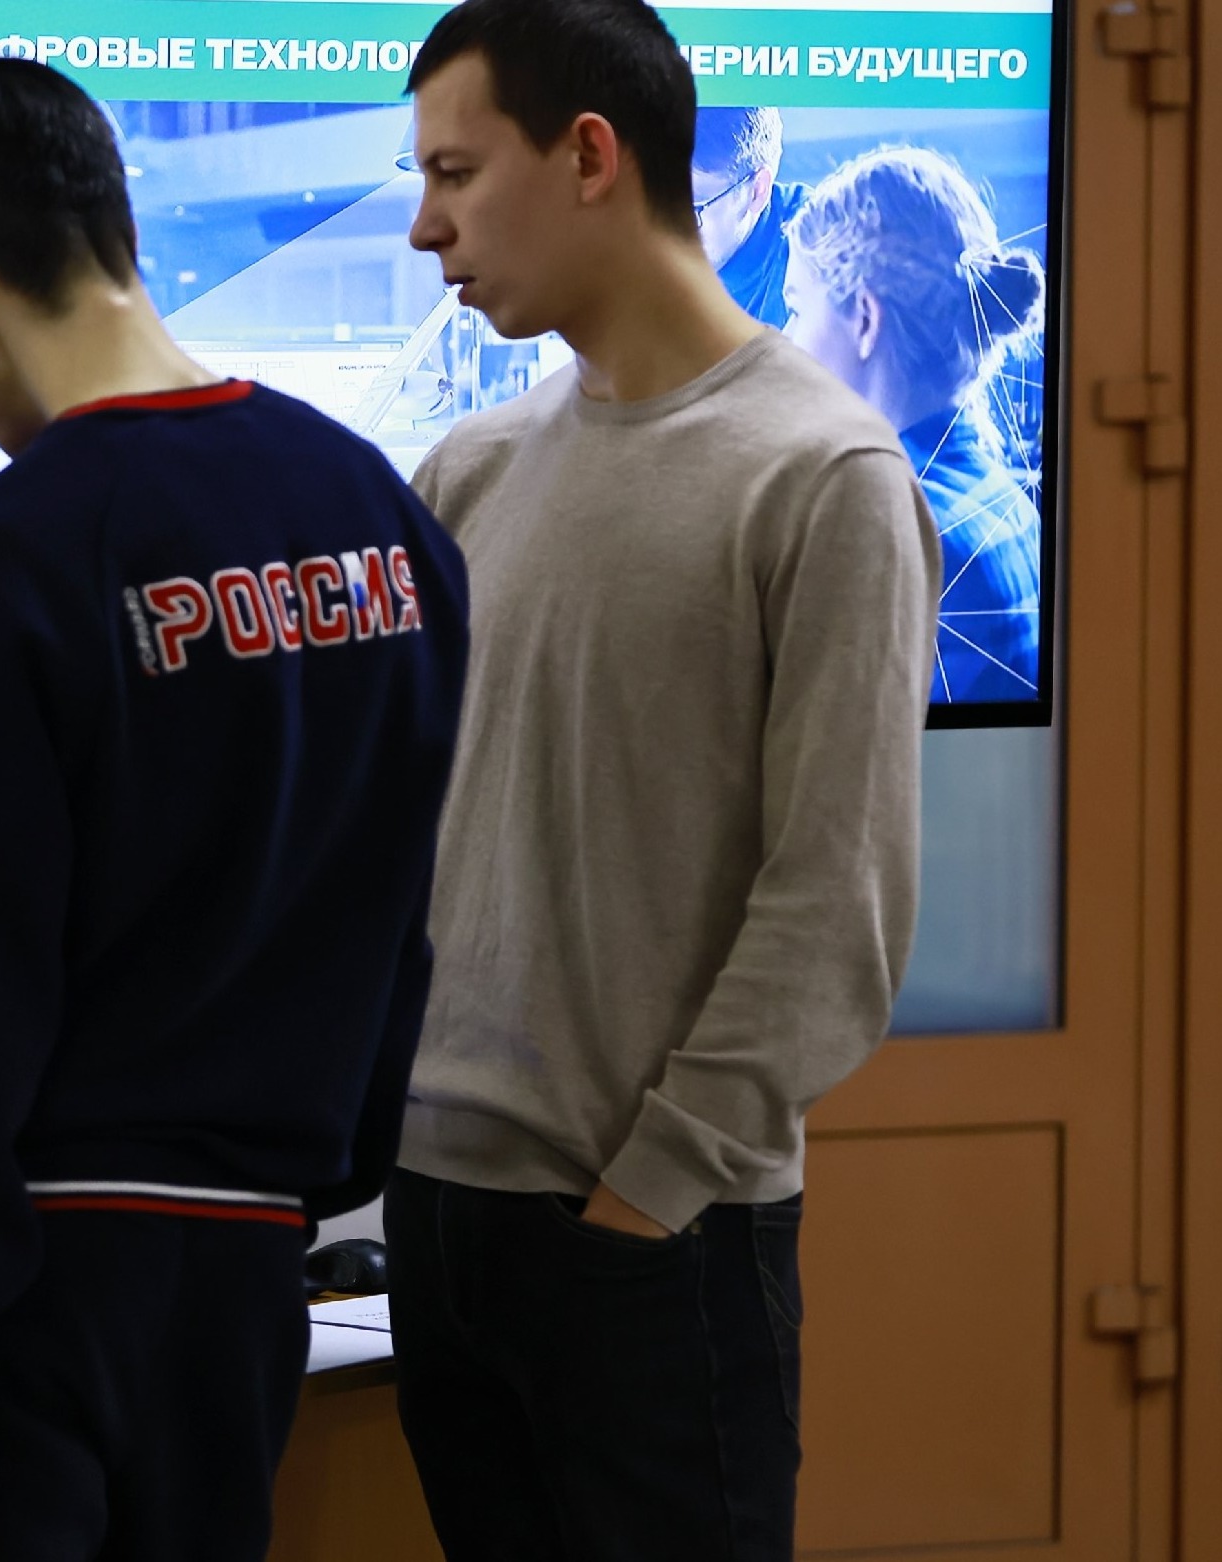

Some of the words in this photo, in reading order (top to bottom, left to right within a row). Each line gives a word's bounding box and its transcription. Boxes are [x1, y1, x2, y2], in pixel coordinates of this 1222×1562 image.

[679, 44, 799, 77] ЕРИИ
[808, 46, 1029, 83] БУДУЩЕГО
[143, 545, 423, 671] РОССИЯ
